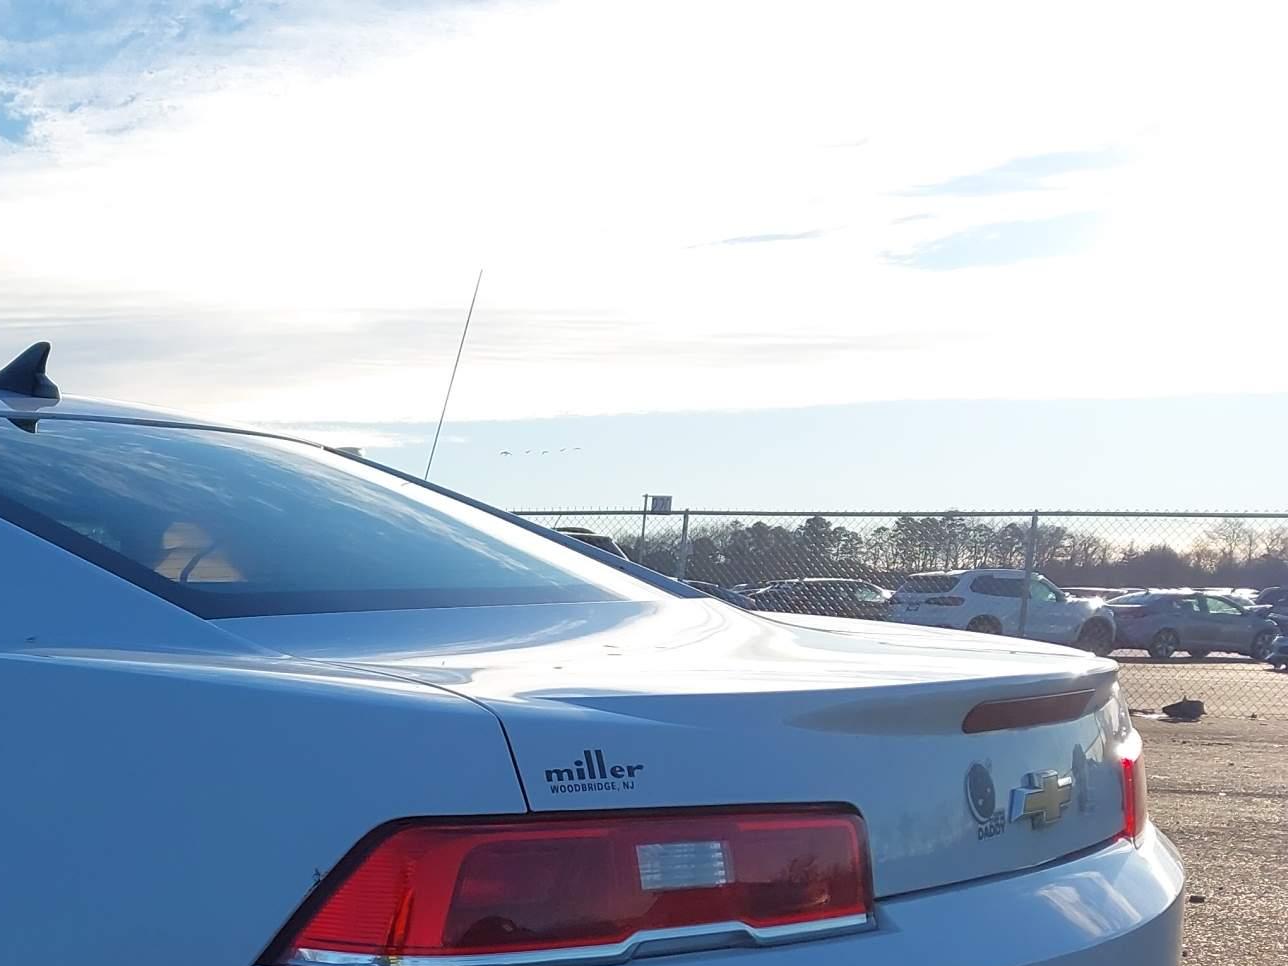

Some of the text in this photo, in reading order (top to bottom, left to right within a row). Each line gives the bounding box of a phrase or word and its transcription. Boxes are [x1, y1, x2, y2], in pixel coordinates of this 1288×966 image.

[545, 750, 644, 782] miller
[550, 781, 635, 794] WOODBRIDGE, NJ
